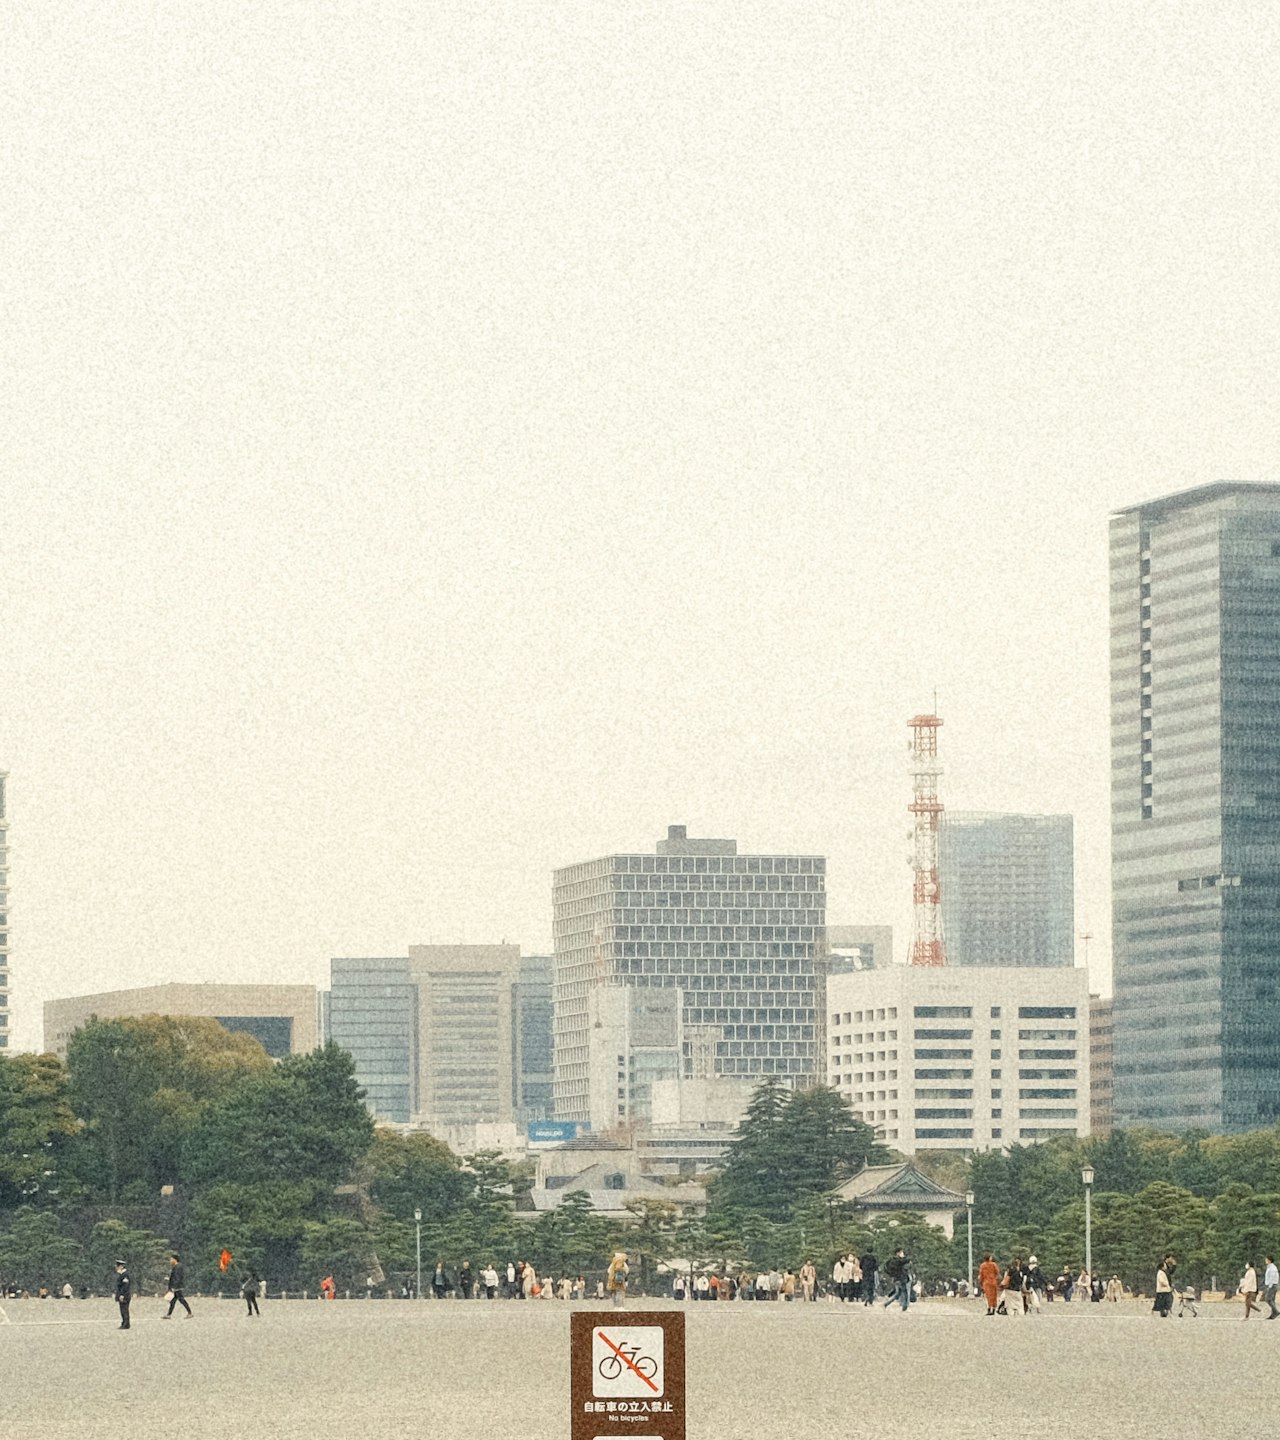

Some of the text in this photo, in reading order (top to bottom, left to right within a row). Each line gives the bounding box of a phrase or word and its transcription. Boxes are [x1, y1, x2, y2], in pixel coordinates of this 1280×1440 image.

[584, 1401, 674, 1413] 自転車の立入禁止
[608, 1414, 649, 1423] No bicycles
